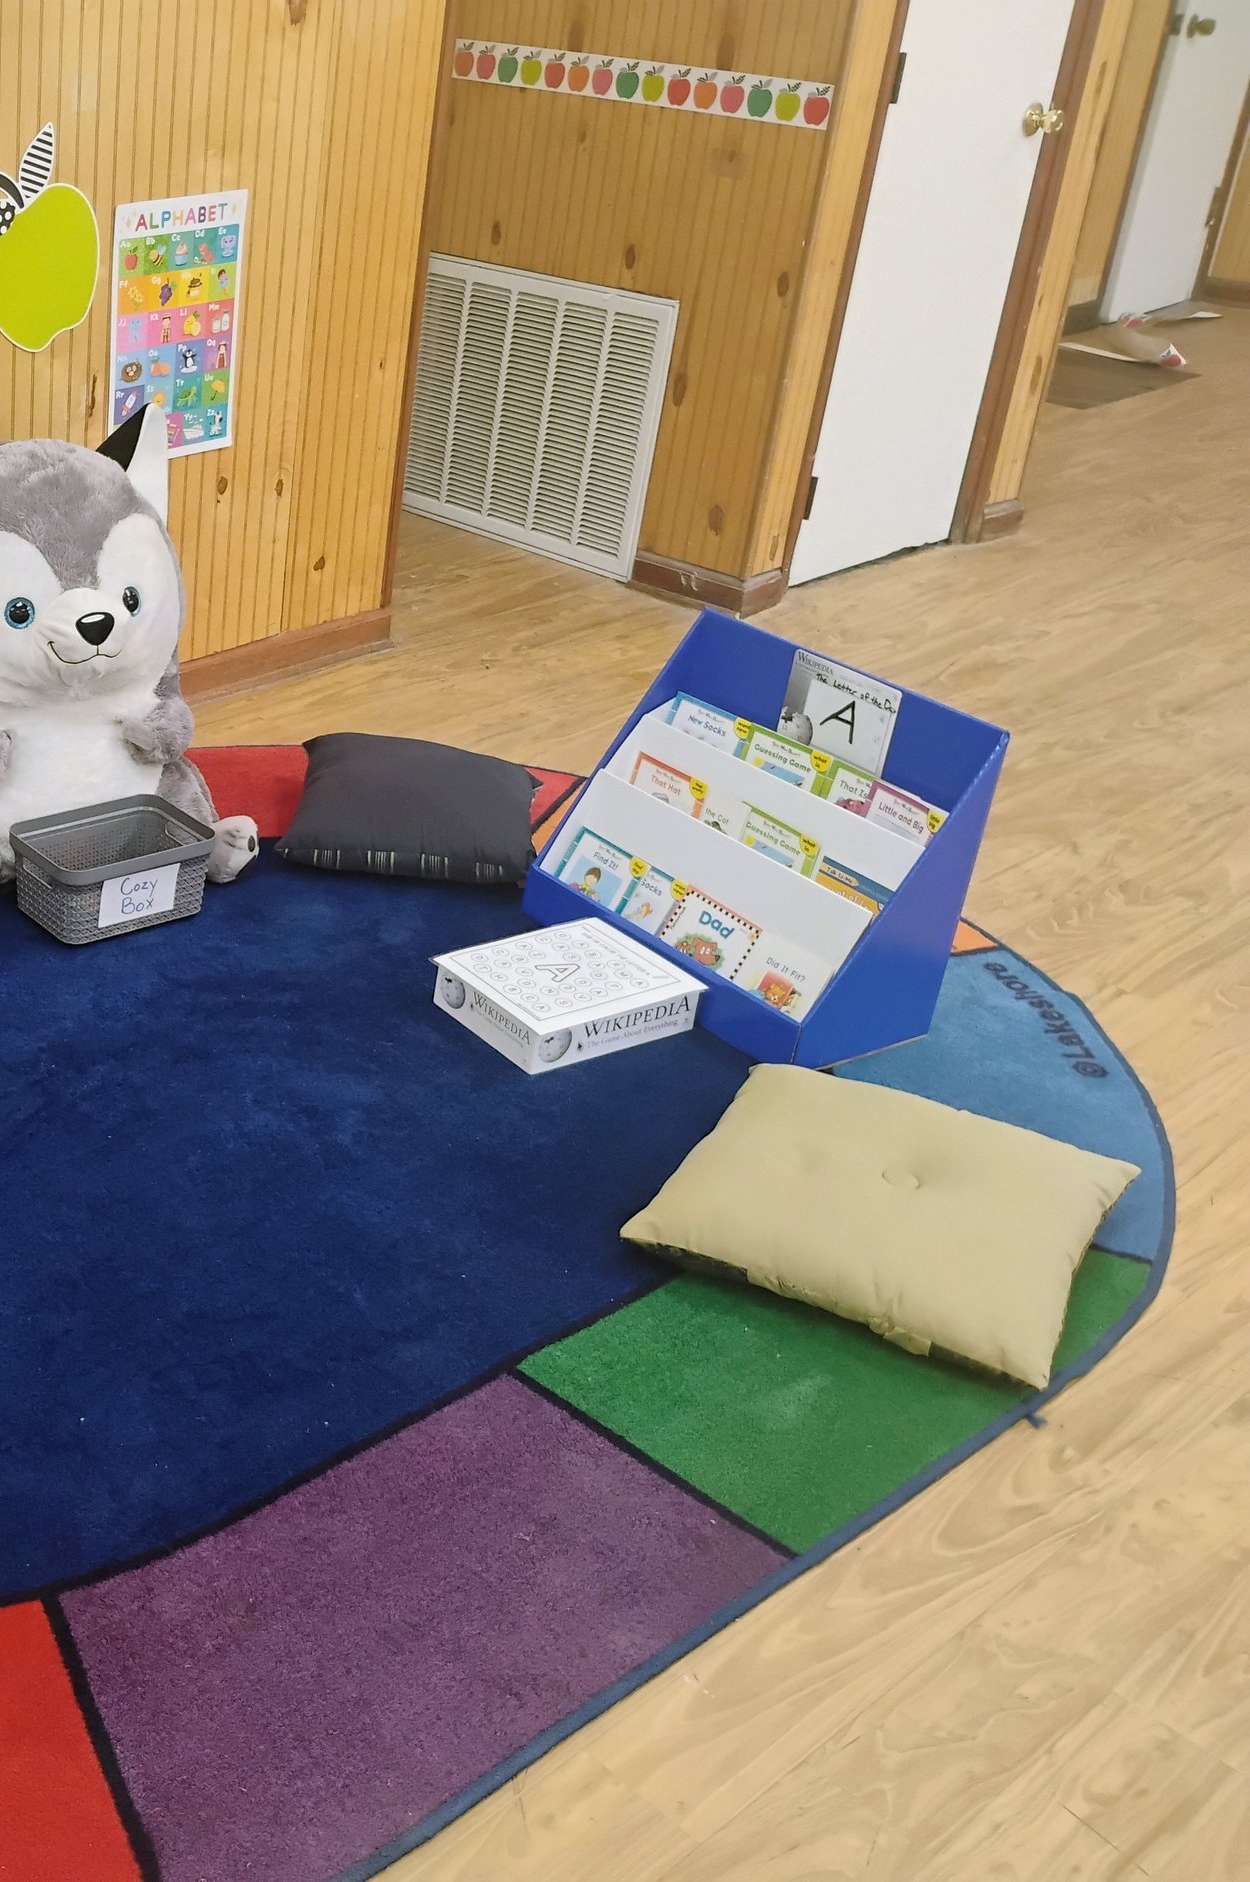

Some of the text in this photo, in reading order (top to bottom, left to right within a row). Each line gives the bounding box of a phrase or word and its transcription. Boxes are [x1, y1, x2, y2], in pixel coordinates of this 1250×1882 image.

[135, 203, 228, 232] ALPHABET
[146, 237, 155, 245] Bb
[195, 229, 205, 238] Dd
[119, 280, 128, 288] Ff
[117, 318, 126, 327] Jj
[178, 344, 186, 353] Pp
[116, 391, 124, 399] Rr
[816, 673, 828, 683] The
[833, 680, 857, 695] Letter
[860, 693, 870, 701] of
[870, 697, 882, 708] the
[688, 714, 703, 727] New
[703, 722, 726, 737] Socks
[819, 700, 856, 744] A
[754, 743, 788, 764] Guessing
[789, 759, 812, 773] Game
[813, 755, 827, 764] what
[651, 775, 667, 789] That
[667, 784, 682, 796] Hat
[840, 780, 857, 793] That
[705, 807, 716, 818] the
[878, 801, 897, 817] Little
[898, 812, 912, 826] and
[913, 821, 924, 834] Big
[745, 821, 778, 844] Guessing
[779, 840, 801, 856] Game
[593, 851, 609, 865] Find
[608, 861, 619, 871] It!
[120, 877, 158, 897] Cozy
[640, 878, 662, 897] Socks
[121, 897, 154, 915] Box
[698, 910, 735, 939] Dad
[534, 963, 580, 982] A
[766, 957, 806, 982] Did It Fit?
[473, 991, 531, 1045] WIKIPEDIA
[584, 995, 691, 1038] WIKIPEDIA
[587, 1040, 599, 1049] The
[601, 1035, 622, 1045] Game
[624, 1029, 642, 1039] About
[644, 1020, 679, 1034] Everything
